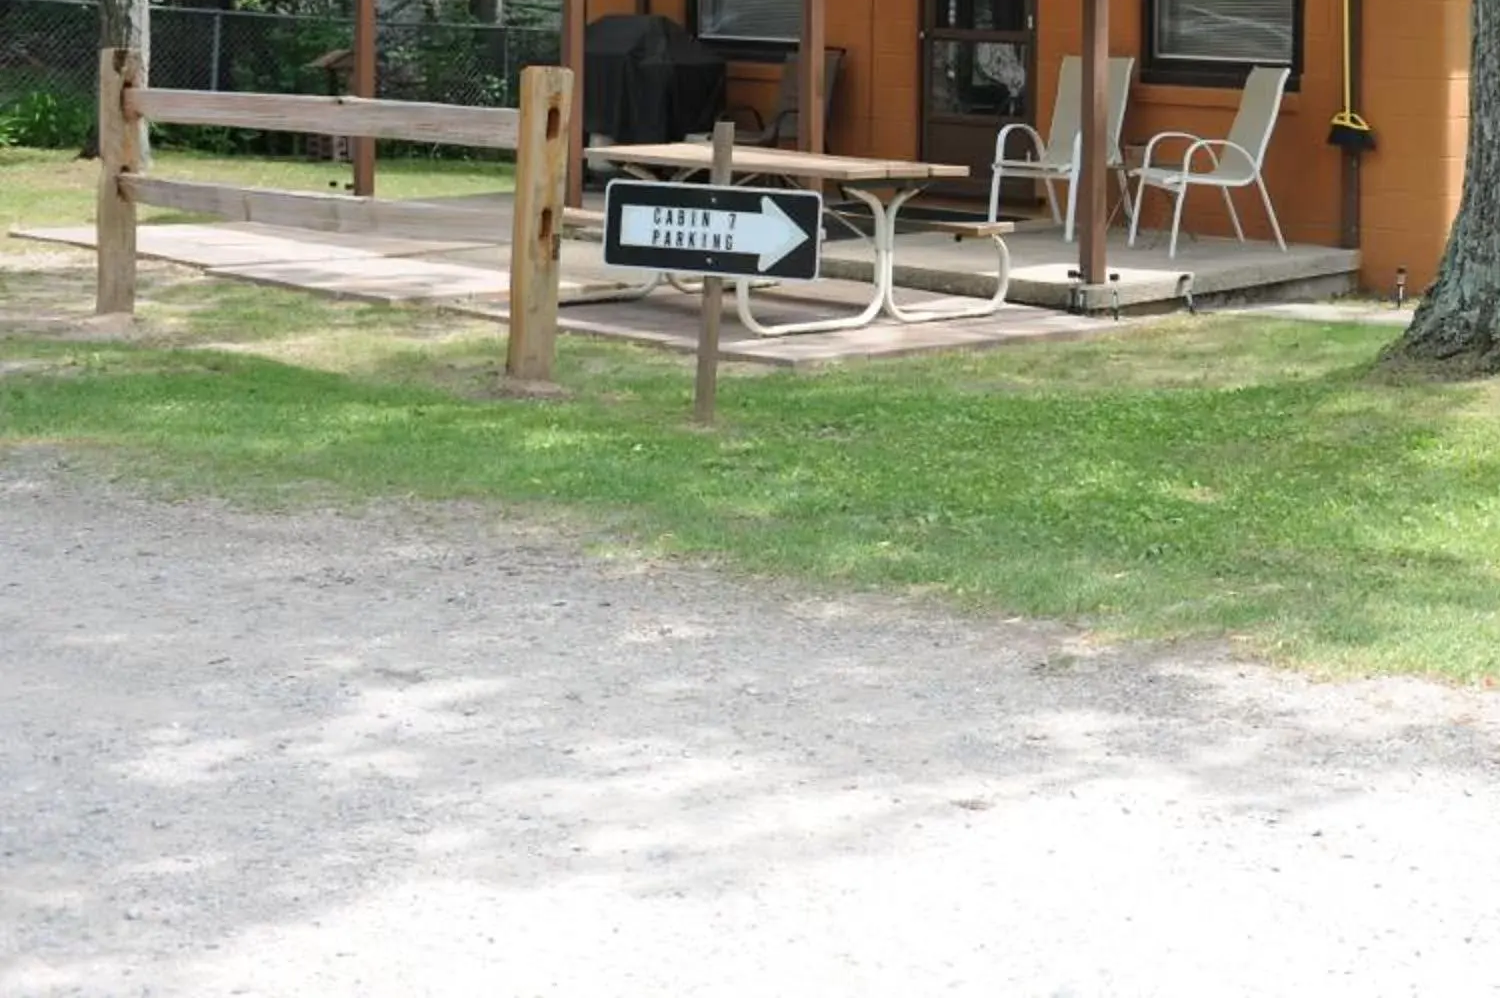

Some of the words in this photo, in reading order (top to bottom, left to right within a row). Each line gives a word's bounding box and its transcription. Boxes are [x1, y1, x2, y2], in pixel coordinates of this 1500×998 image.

[652, 207, 711, 227] CABIN
[728, 213, 737, 228] 7
[651, 230, 733, 251] PARKING
